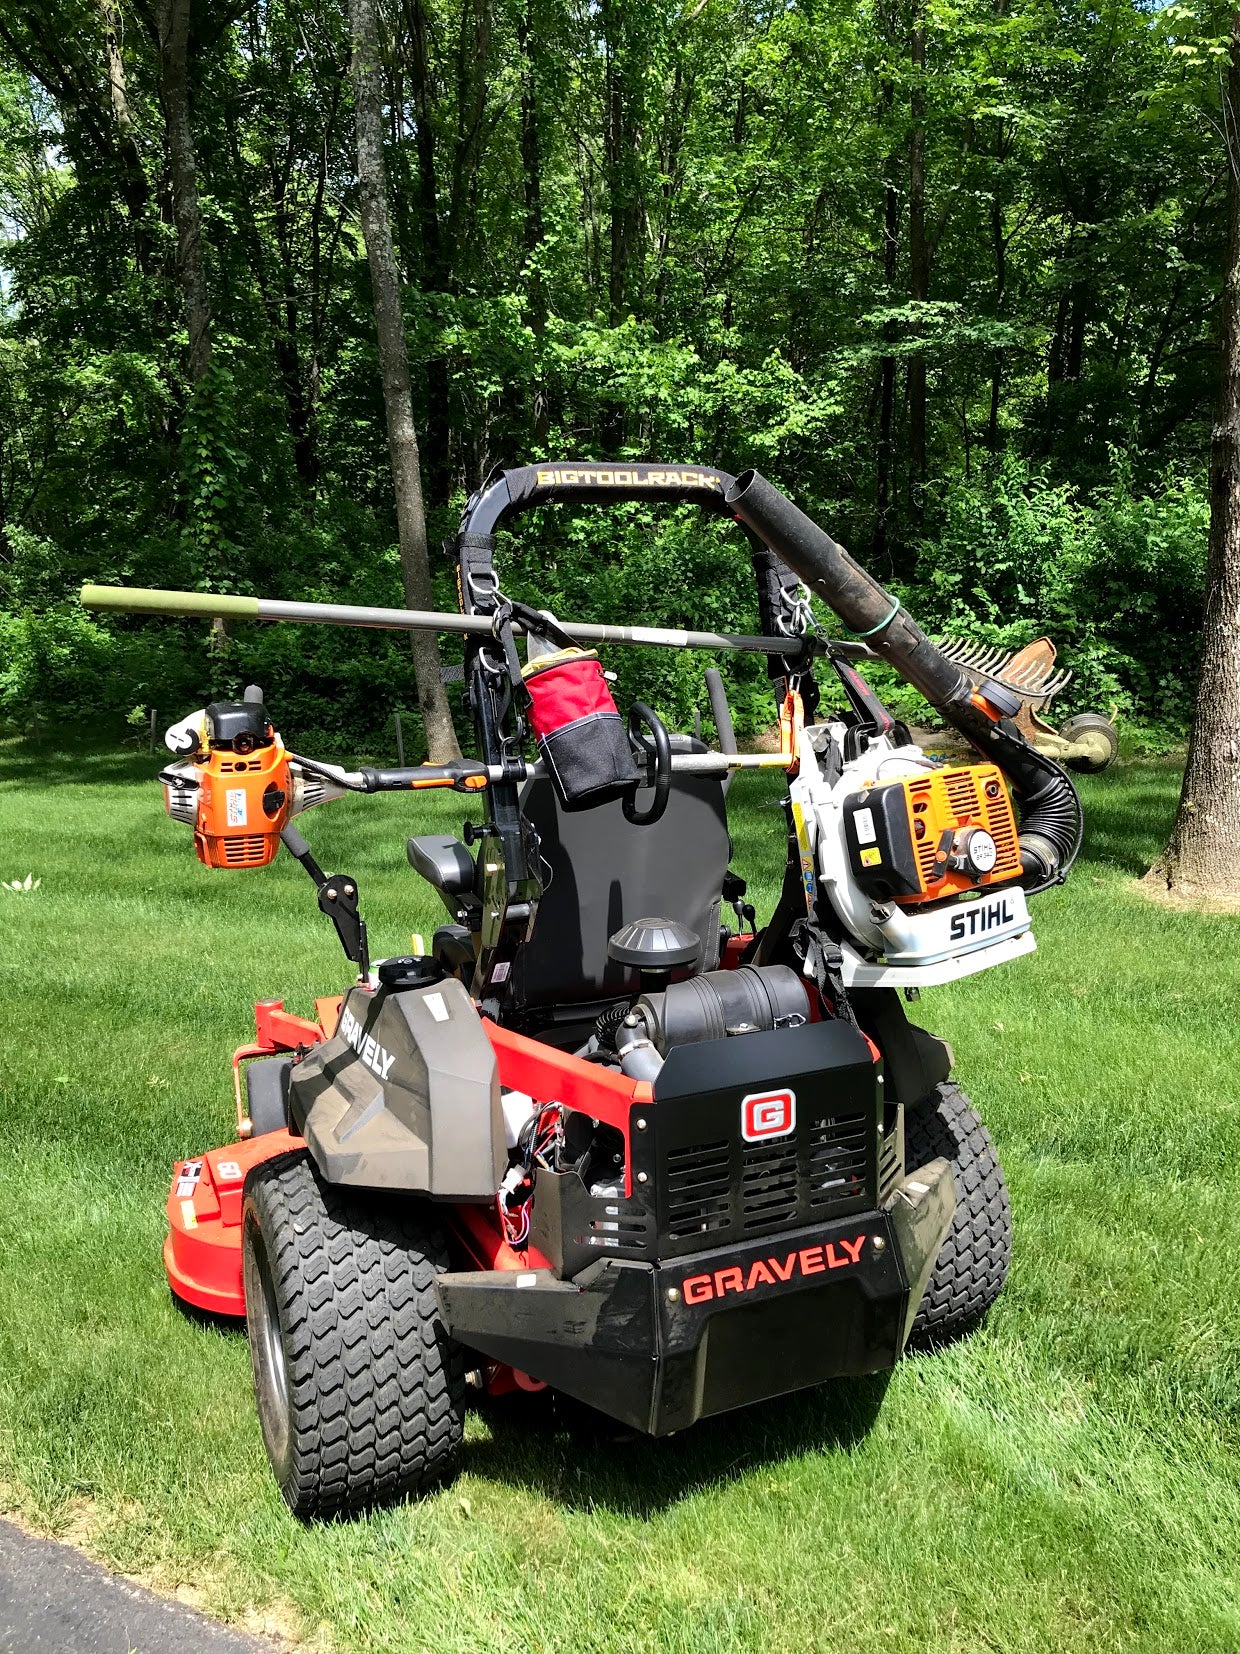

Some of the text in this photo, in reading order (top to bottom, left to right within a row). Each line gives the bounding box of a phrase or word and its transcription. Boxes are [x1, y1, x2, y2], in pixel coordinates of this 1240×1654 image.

[536, 470, 716, 489] BIGTOOLRACK
[973, 843, 993, 854] STIHL
[950, 899, 1014, 941] STIHL
[341, 1006, 396, 1080] GRAVELY
[682, 1235, 867, 1306] GRAVELY
